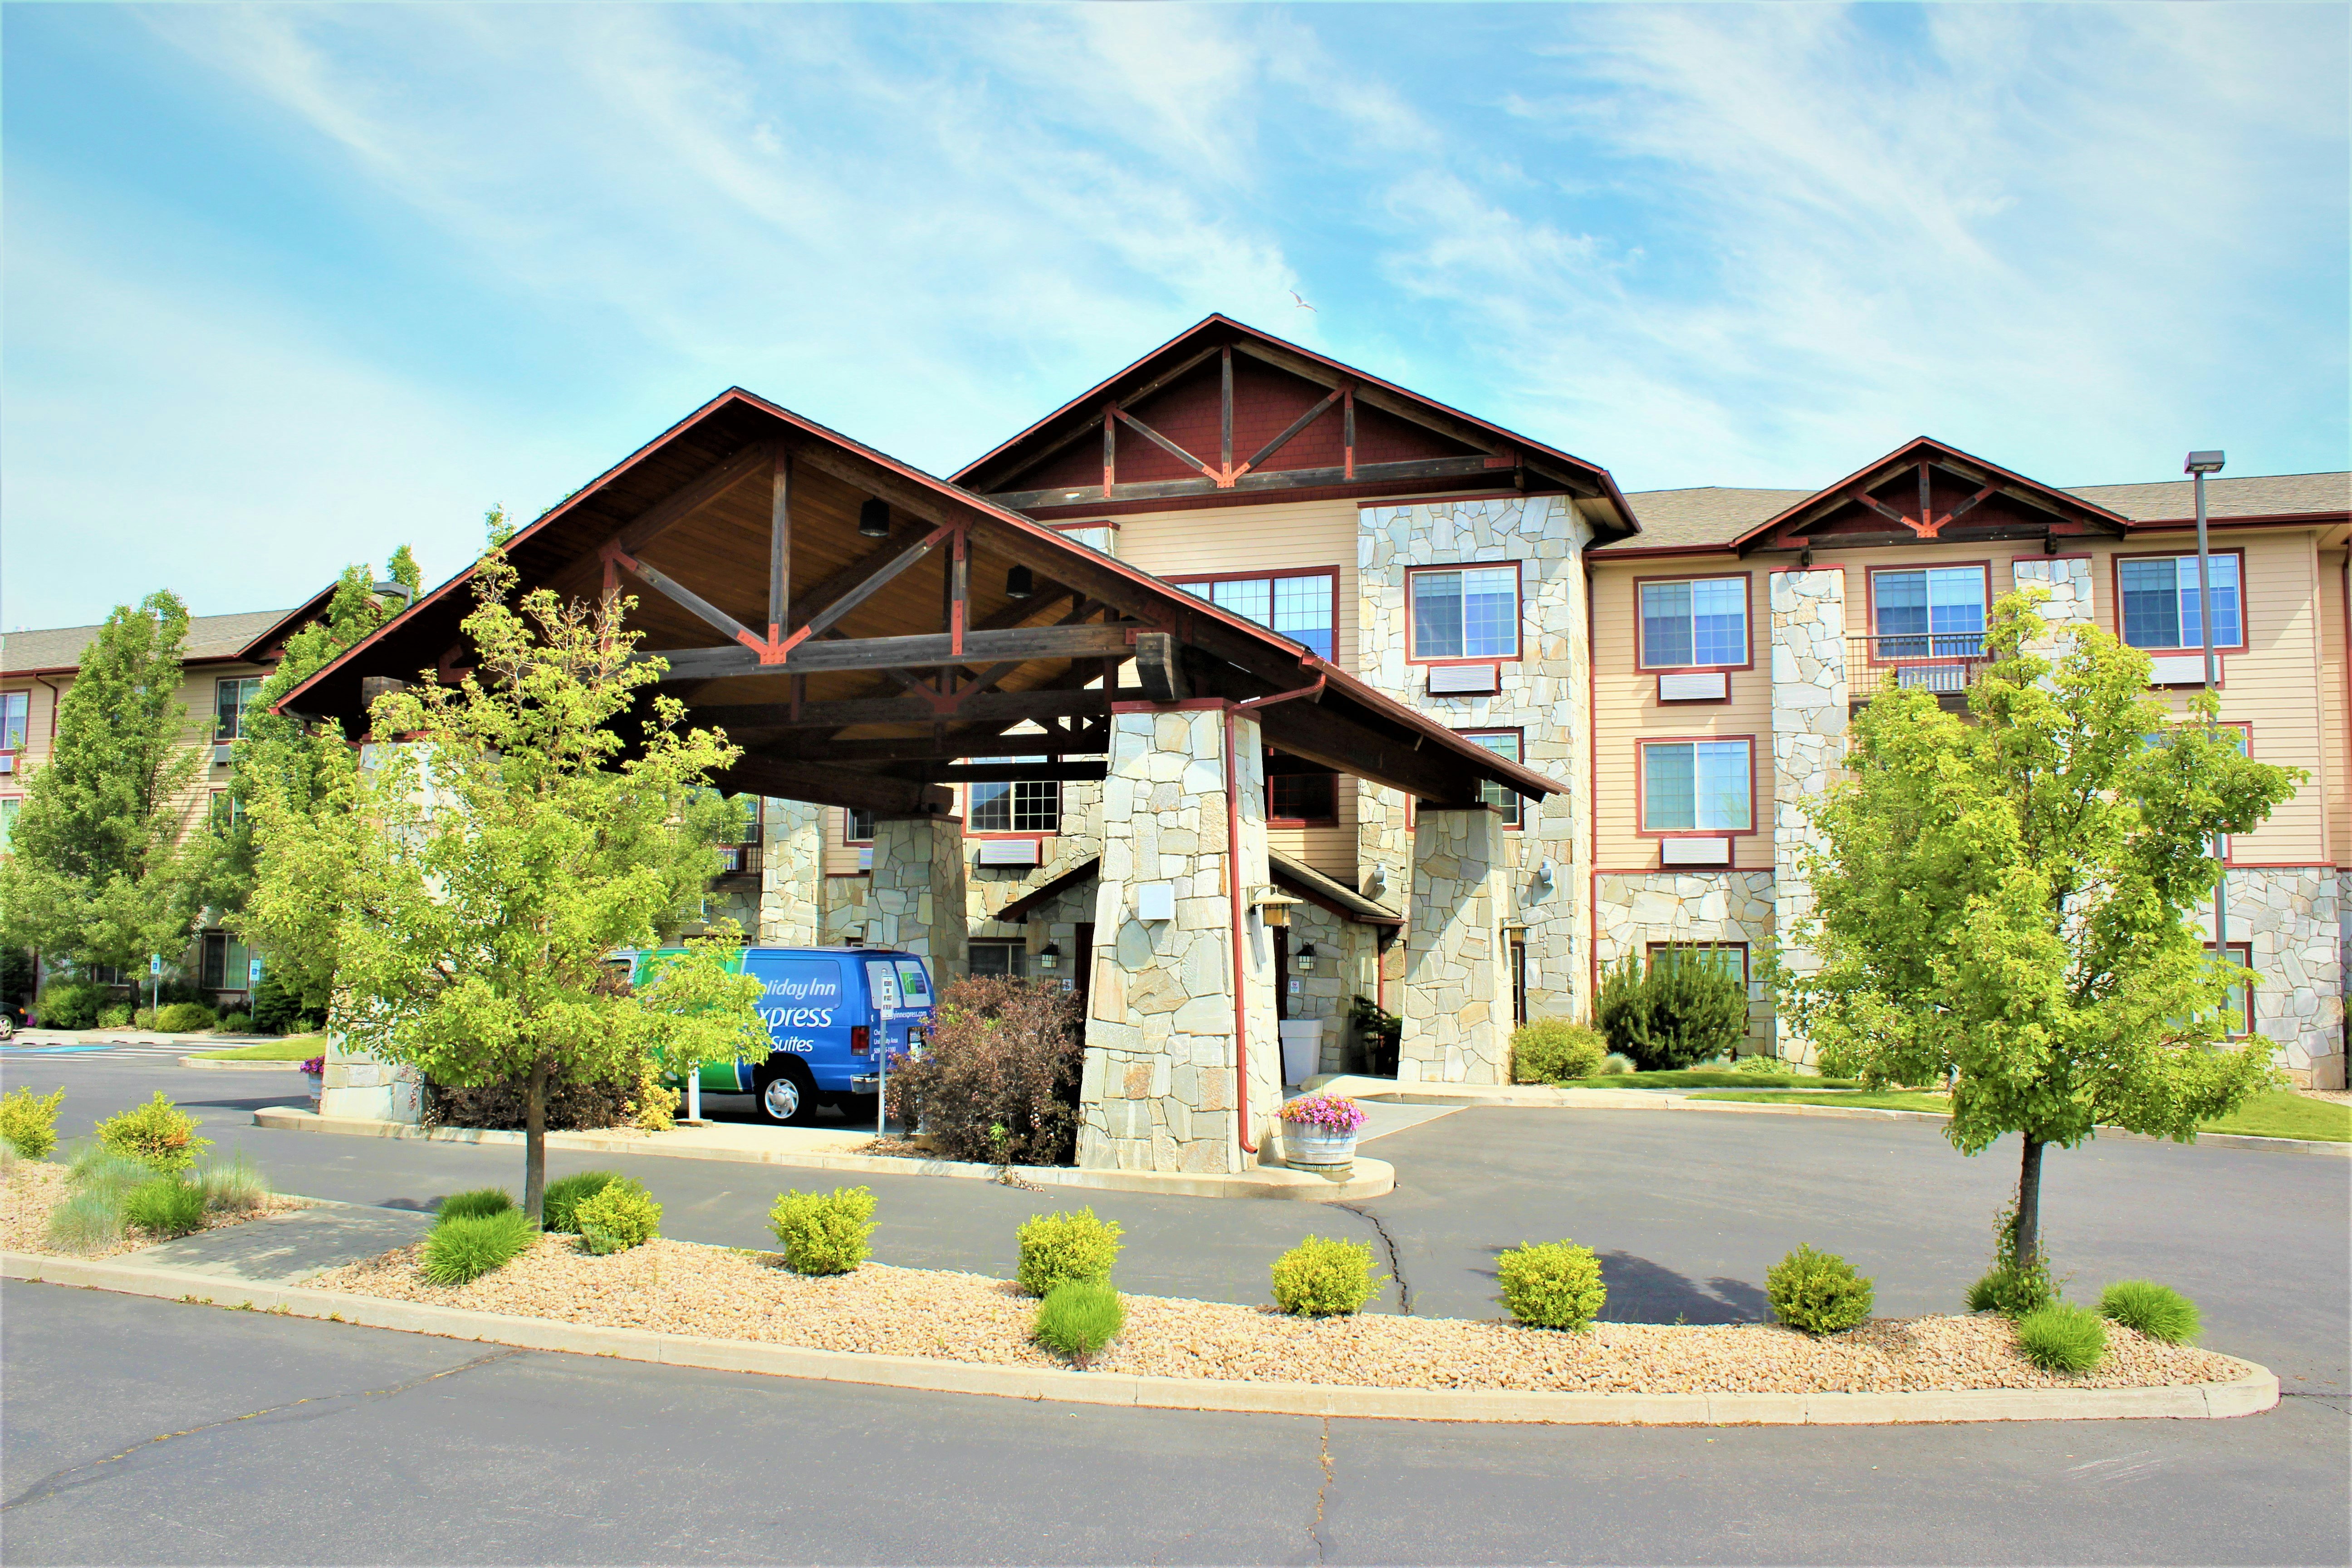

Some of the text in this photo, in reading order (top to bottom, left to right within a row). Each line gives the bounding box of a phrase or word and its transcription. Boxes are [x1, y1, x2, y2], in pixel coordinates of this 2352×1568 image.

[761, 977, 836, 1000] oliday Inn
[756, 1007, 833, 1034] xpress
[771, 1035, 814, 1053] Suites
